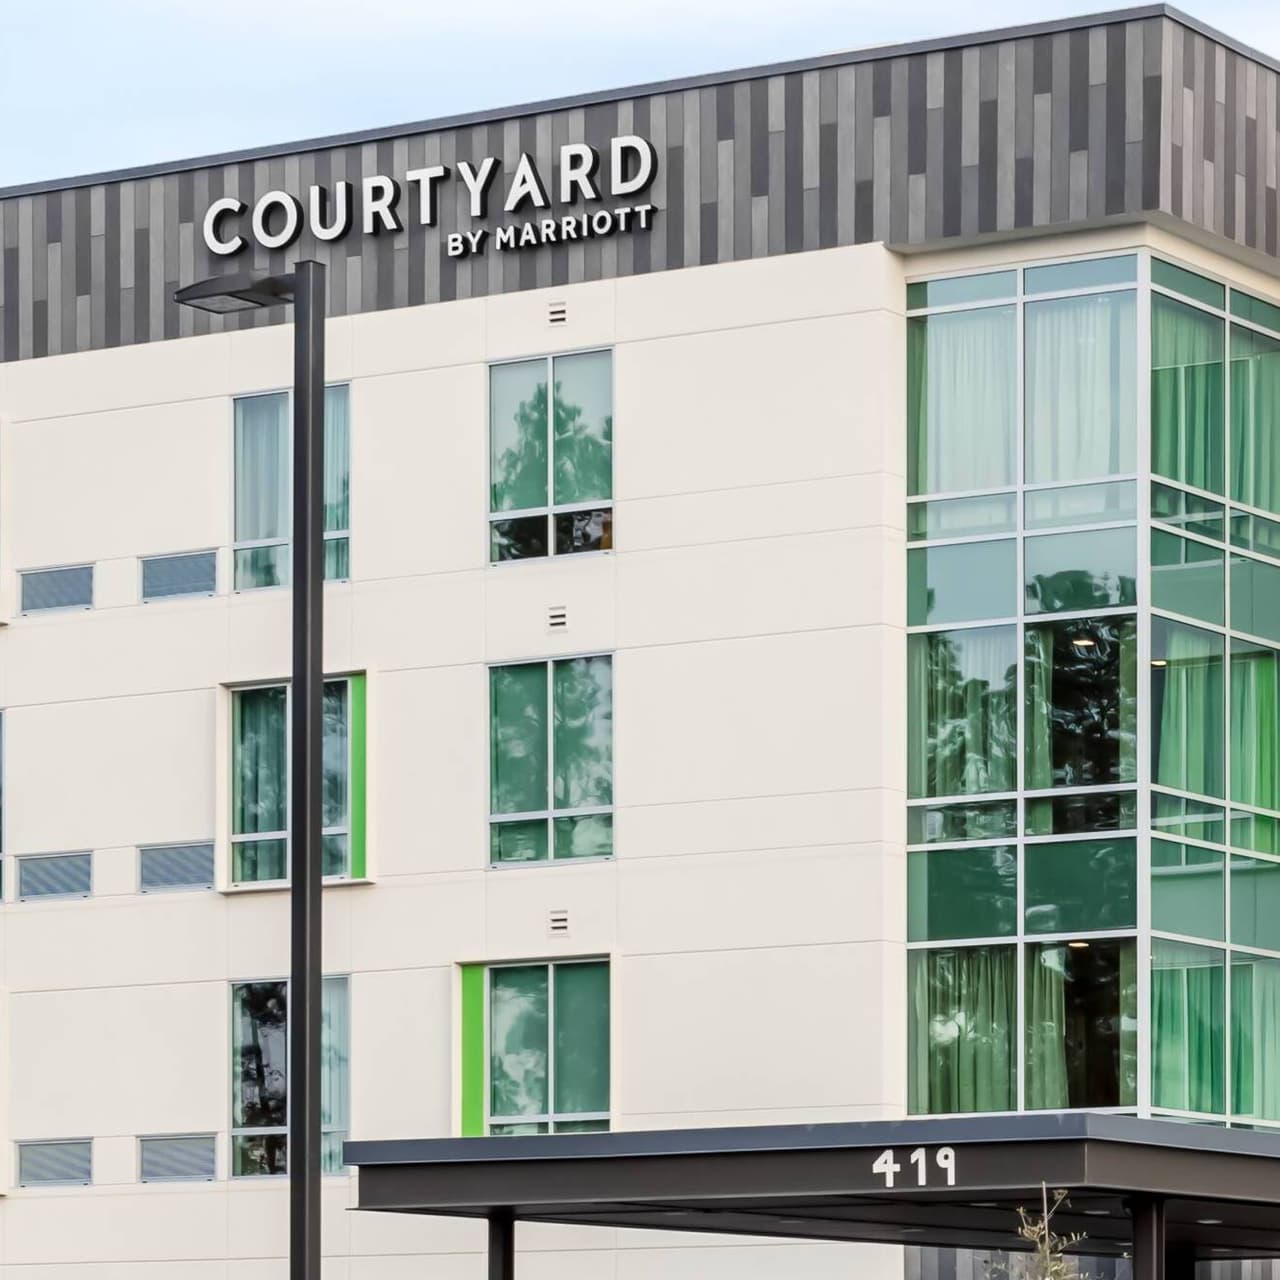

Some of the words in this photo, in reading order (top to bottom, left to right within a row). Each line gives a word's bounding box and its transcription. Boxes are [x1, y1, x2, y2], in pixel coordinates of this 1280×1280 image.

[203, 135, 654, 255] COURTYARD
[447, 229, 485, 257] BY
[495, 204, 654, 251] MARRIOTT
[872, 1147, 955, 1188] 419
